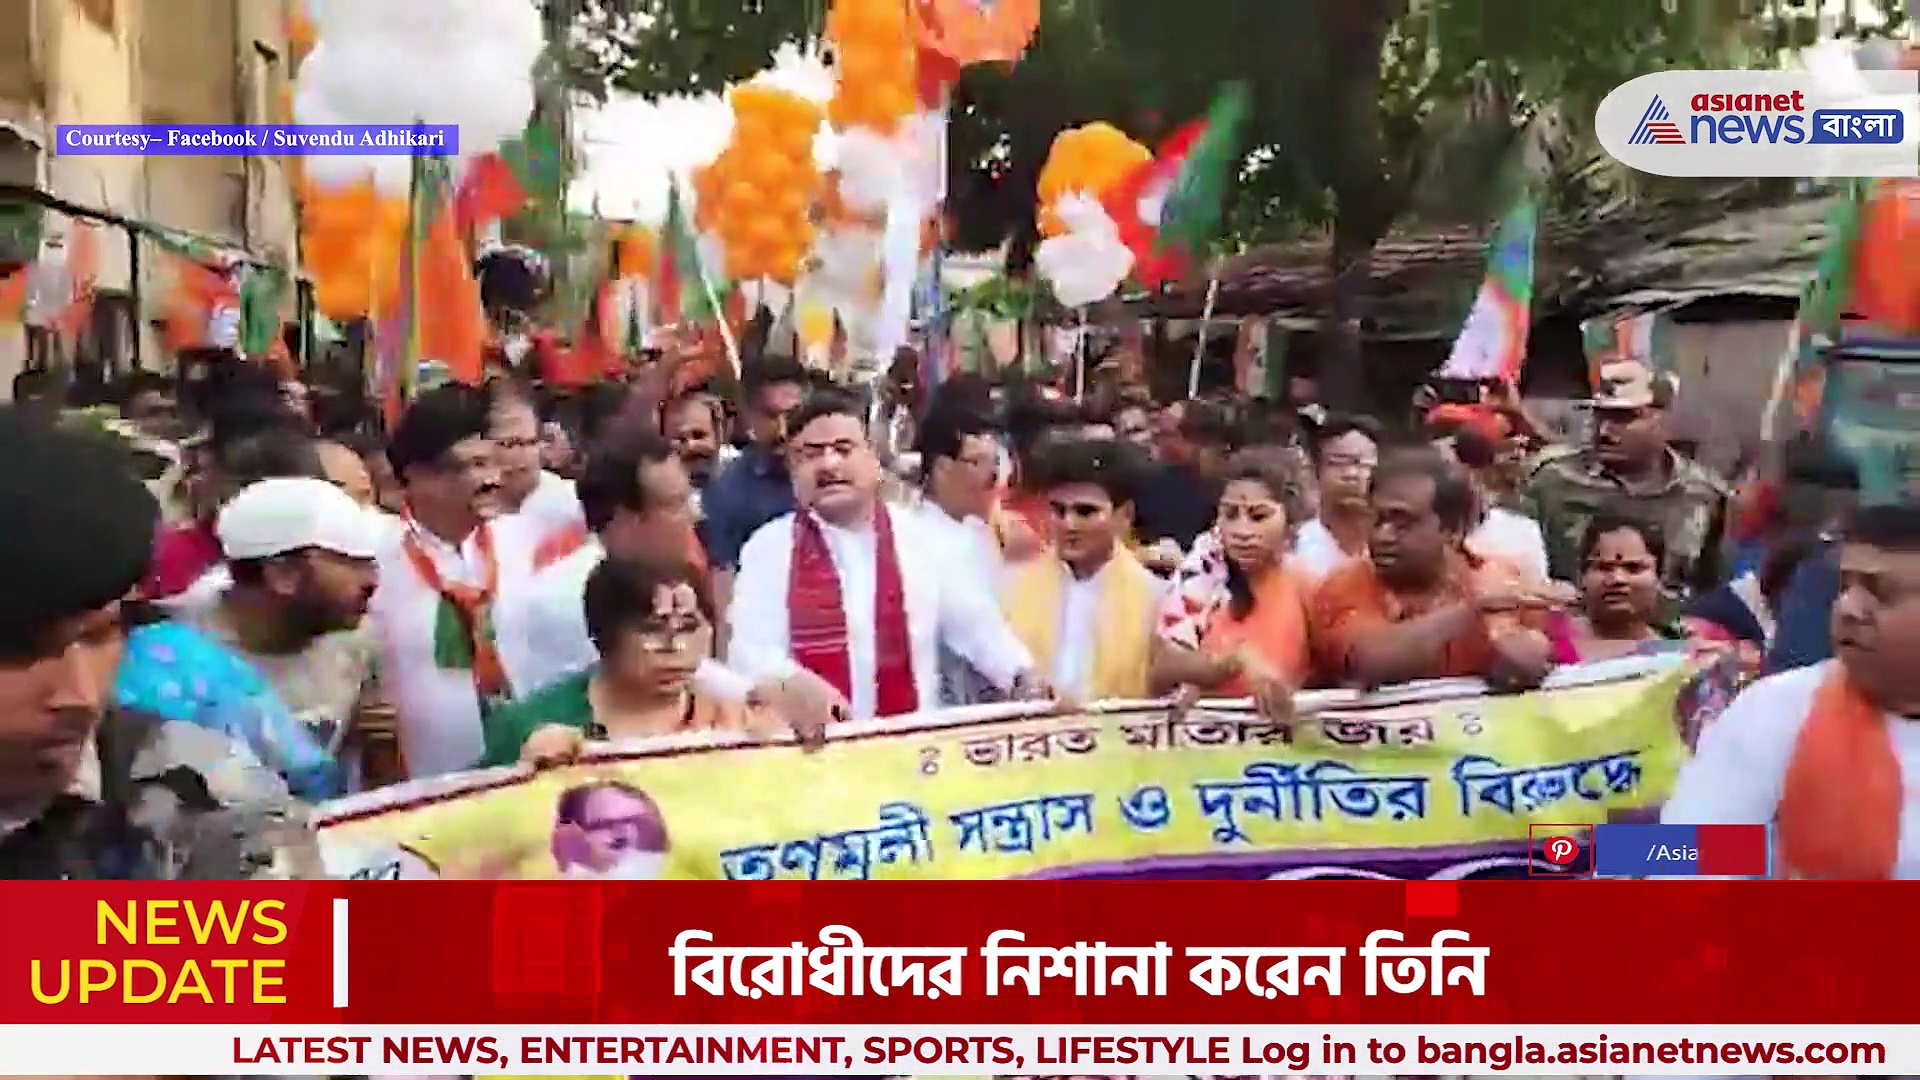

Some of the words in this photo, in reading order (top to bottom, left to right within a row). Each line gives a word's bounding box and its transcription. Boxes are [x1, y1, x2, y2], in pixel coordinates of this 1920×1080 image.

[961, 727, 1100, 766] ভারত
[949, 793, 1094, 853] সন্ত্রাস
[1119, 785, 1170, 829] ও
[1192, 760, 1430, 843] দুর্নীতির
